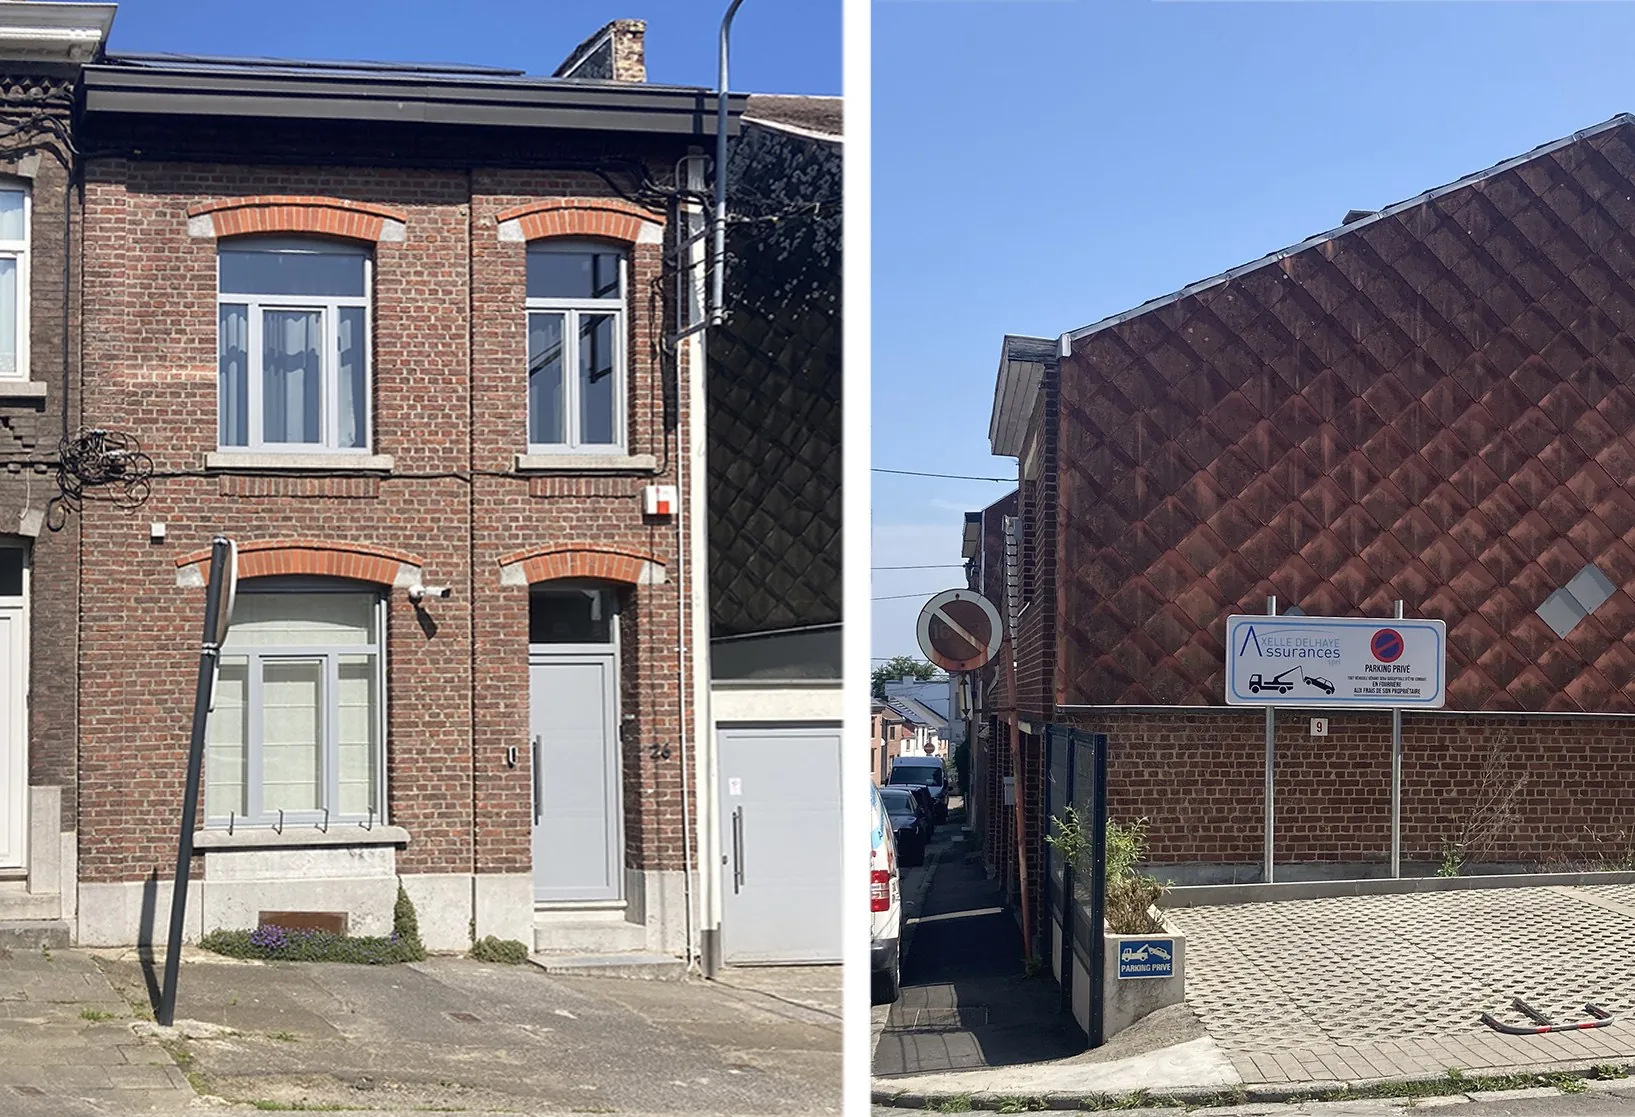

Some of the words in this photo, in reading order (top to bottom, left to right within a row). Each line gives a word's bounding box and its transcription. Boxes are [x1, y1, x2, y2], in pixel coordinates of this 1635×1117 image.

[1295, 637, 1340, 648] DELHAYE
[1365, 664, 1391, 673] PARKING
[1393, 664, 1411, 673] PRIVÉ
[1316, 721, 1323, 733] 9
[650, 743, 671, 760] 26
